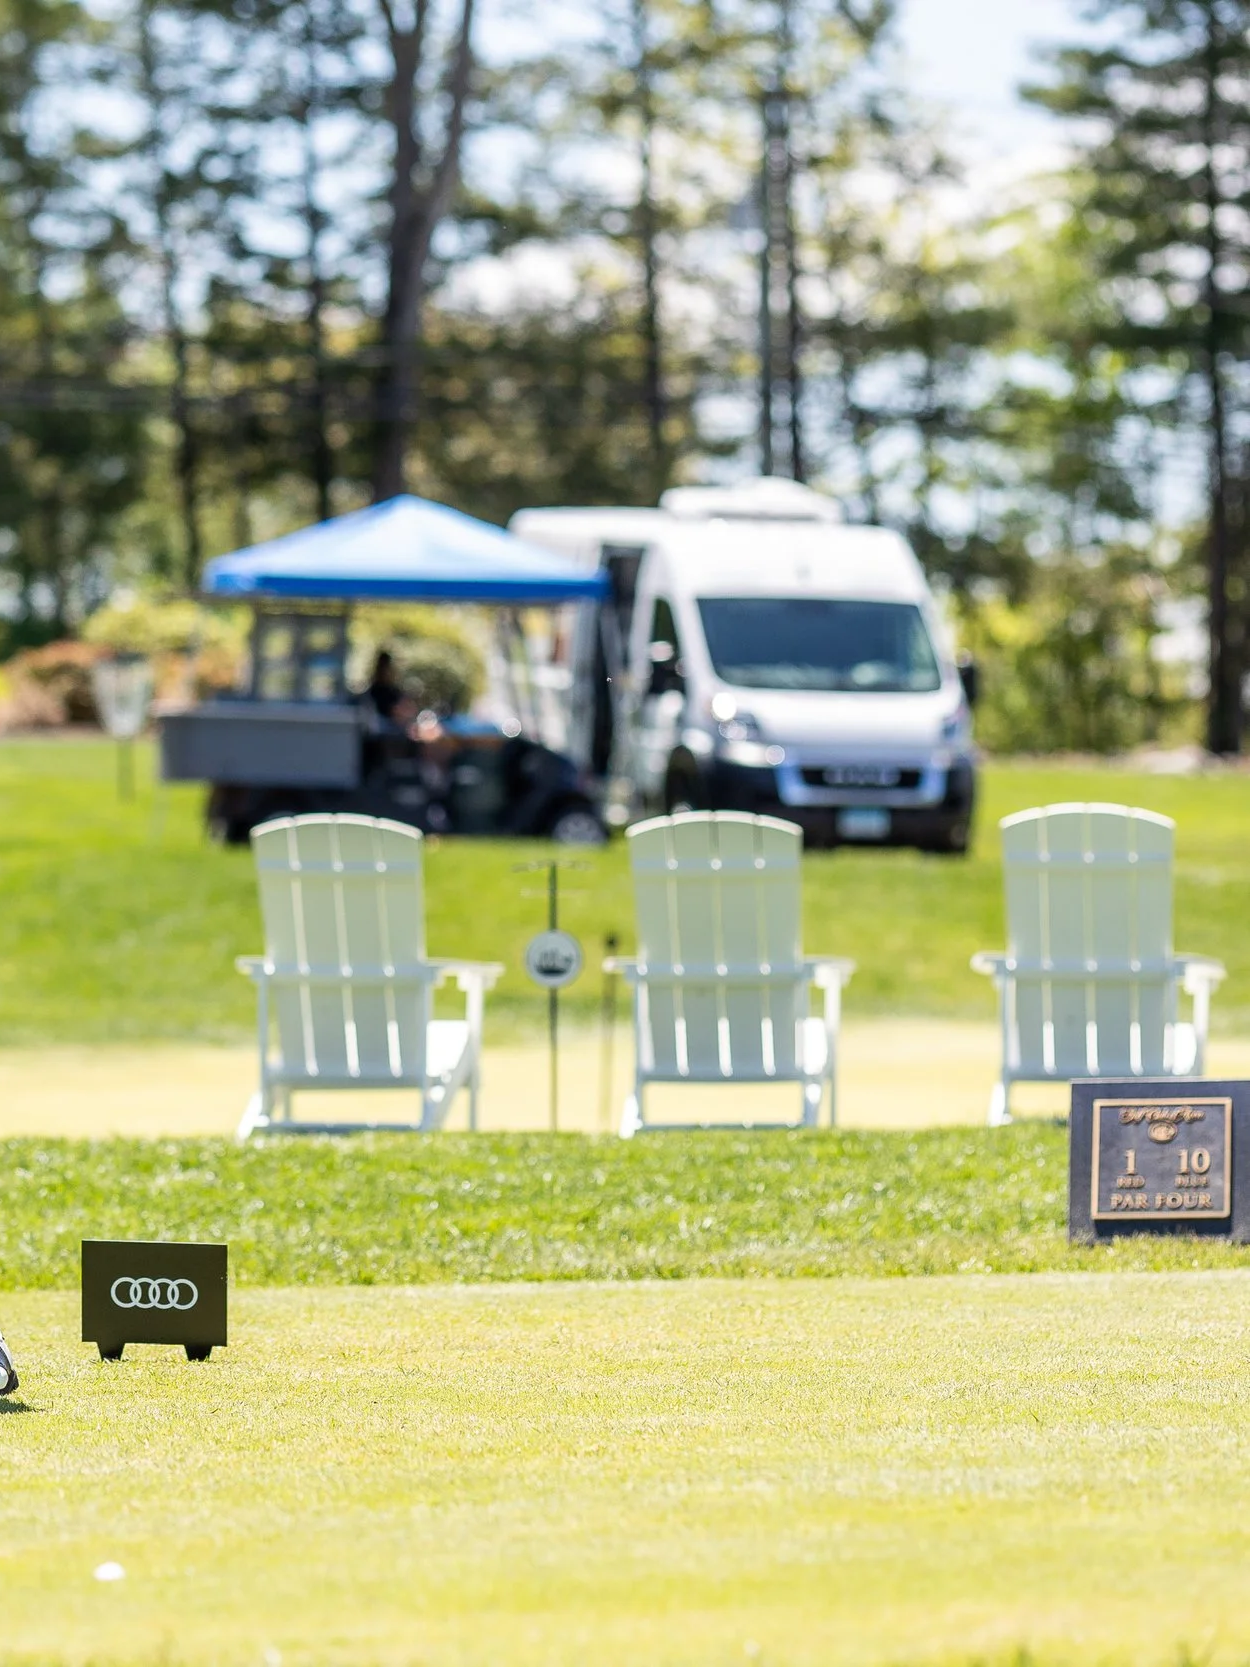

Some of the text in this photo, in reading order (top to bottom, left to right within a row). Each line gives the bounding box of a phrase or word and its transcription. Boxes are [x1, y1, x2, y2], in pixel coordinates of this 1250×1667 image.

[1124, 1149, 1136, 1175] 1
[1178, 1148, 1211, 1174] 10
[1110, 1191, 1213, 1210] PAR FOUR
